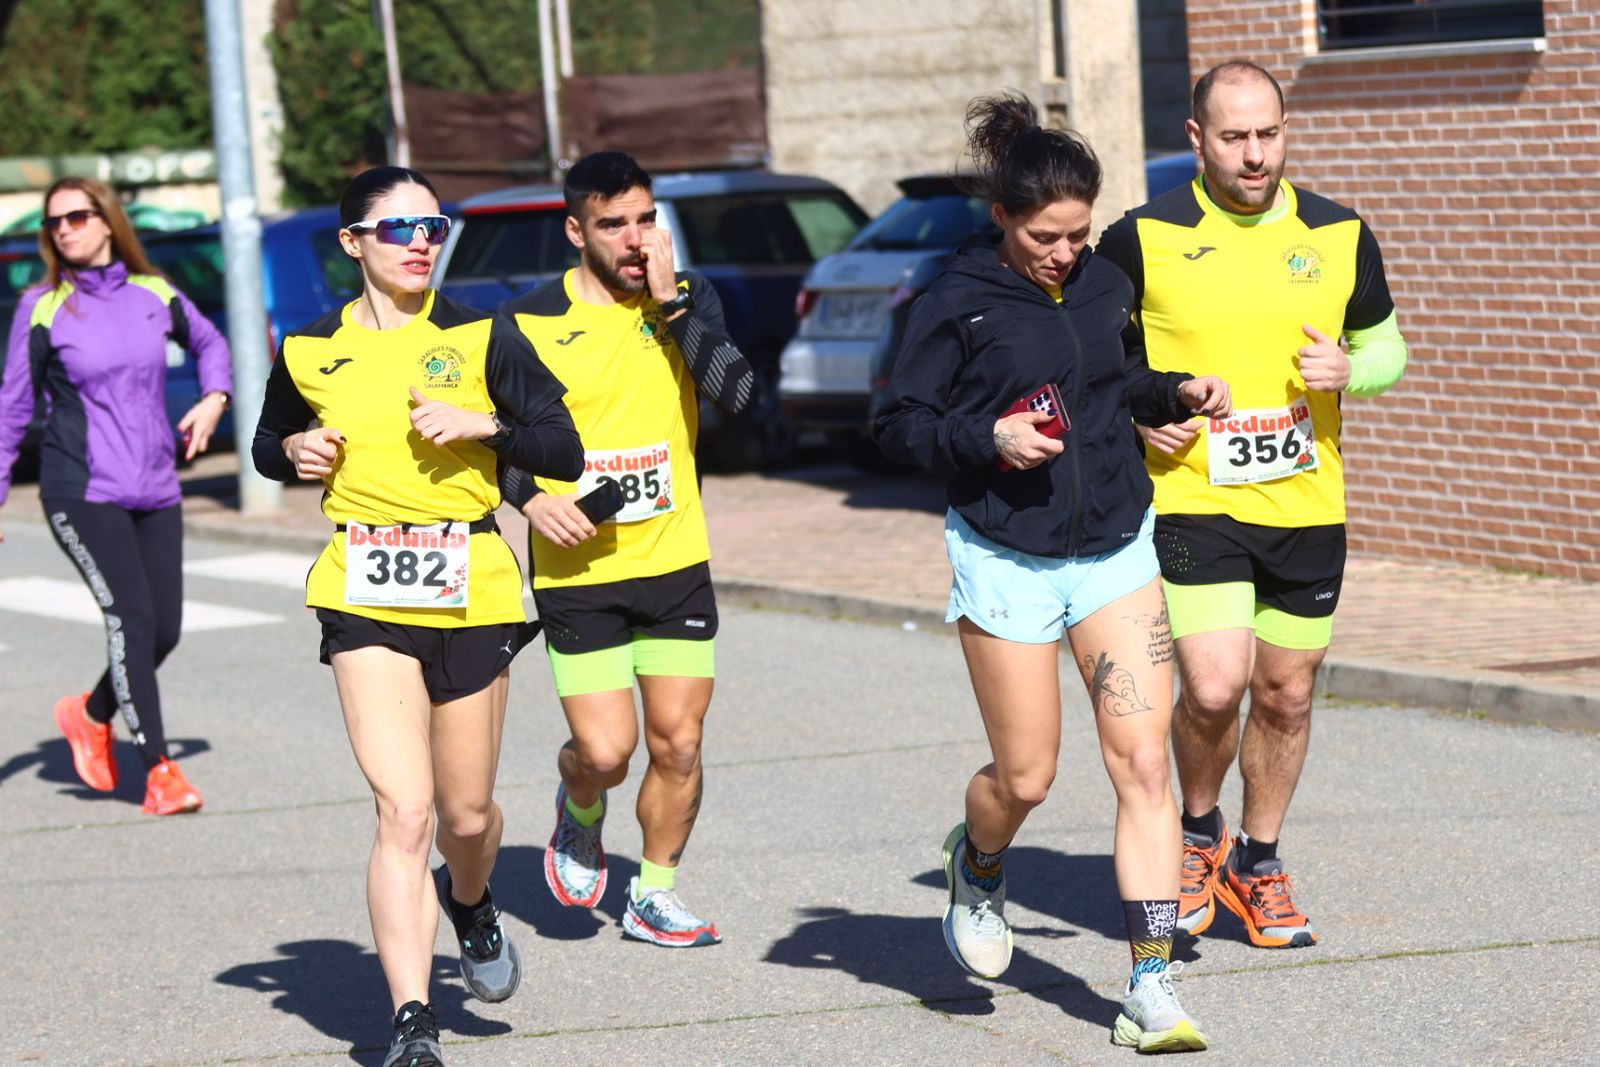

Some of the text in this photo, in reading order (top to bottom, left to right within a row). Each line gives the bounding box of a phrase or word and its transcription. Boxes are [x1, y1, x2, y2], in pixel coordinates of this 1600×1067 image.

[1209, 405, 1309, 434] bedunia
[1228, 428, 1301, 467] 356
[349, 525, 467, 549] bedunia
[51, 511, 115, 608] UNDER
[366, 549, 448, 587] 382
[1142, 901, 1177, 913] WORK
[1146, 911, 1176, 921] HARD
